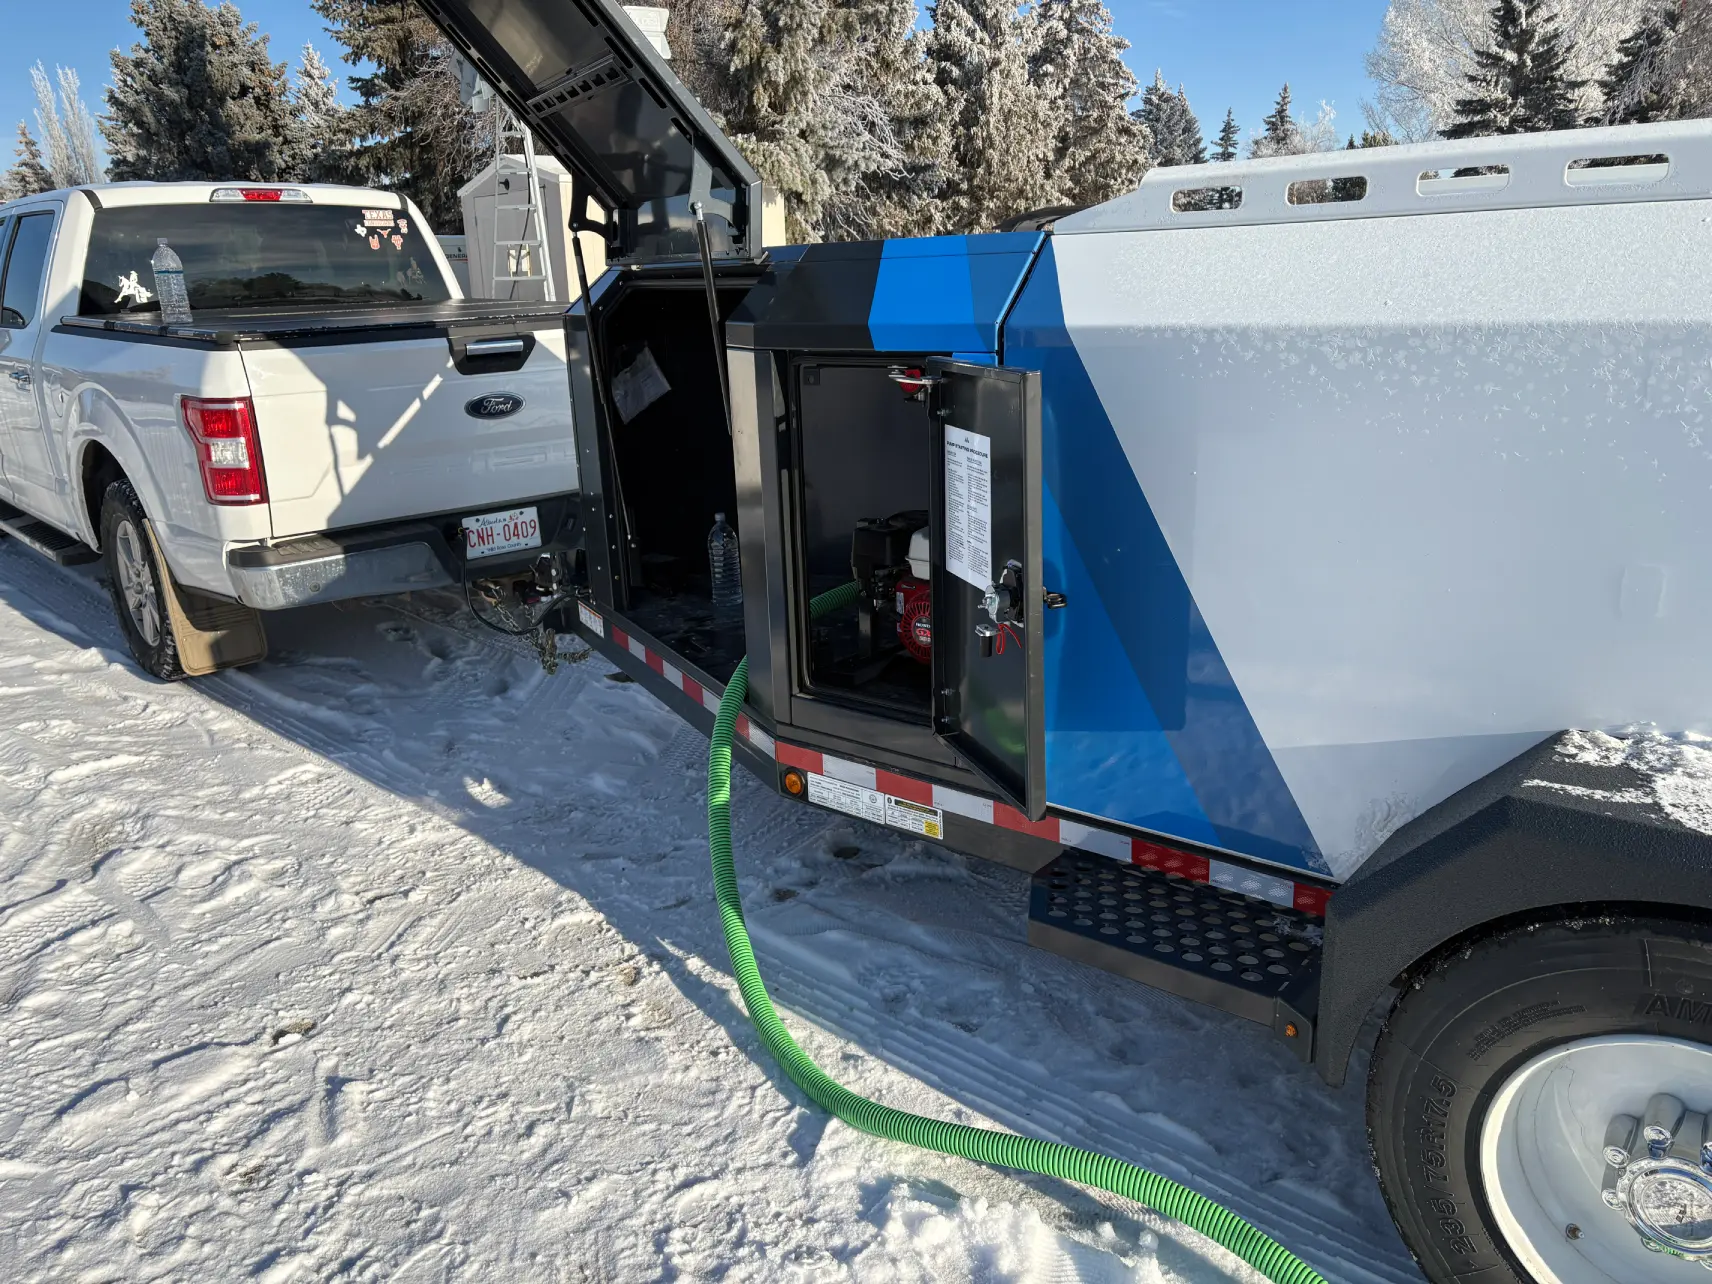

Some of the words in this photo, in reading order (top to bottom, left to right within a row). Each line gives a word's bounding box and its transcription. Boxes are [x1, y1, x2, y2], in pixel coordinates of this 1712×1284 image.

[362, 209, 393, 219] TEXAS
[480, 397, 512, 413] Ford
[467, 519, 537, 548] CNH-0409
[1420, 1074, 1478, 1256] 235/75R17.5
